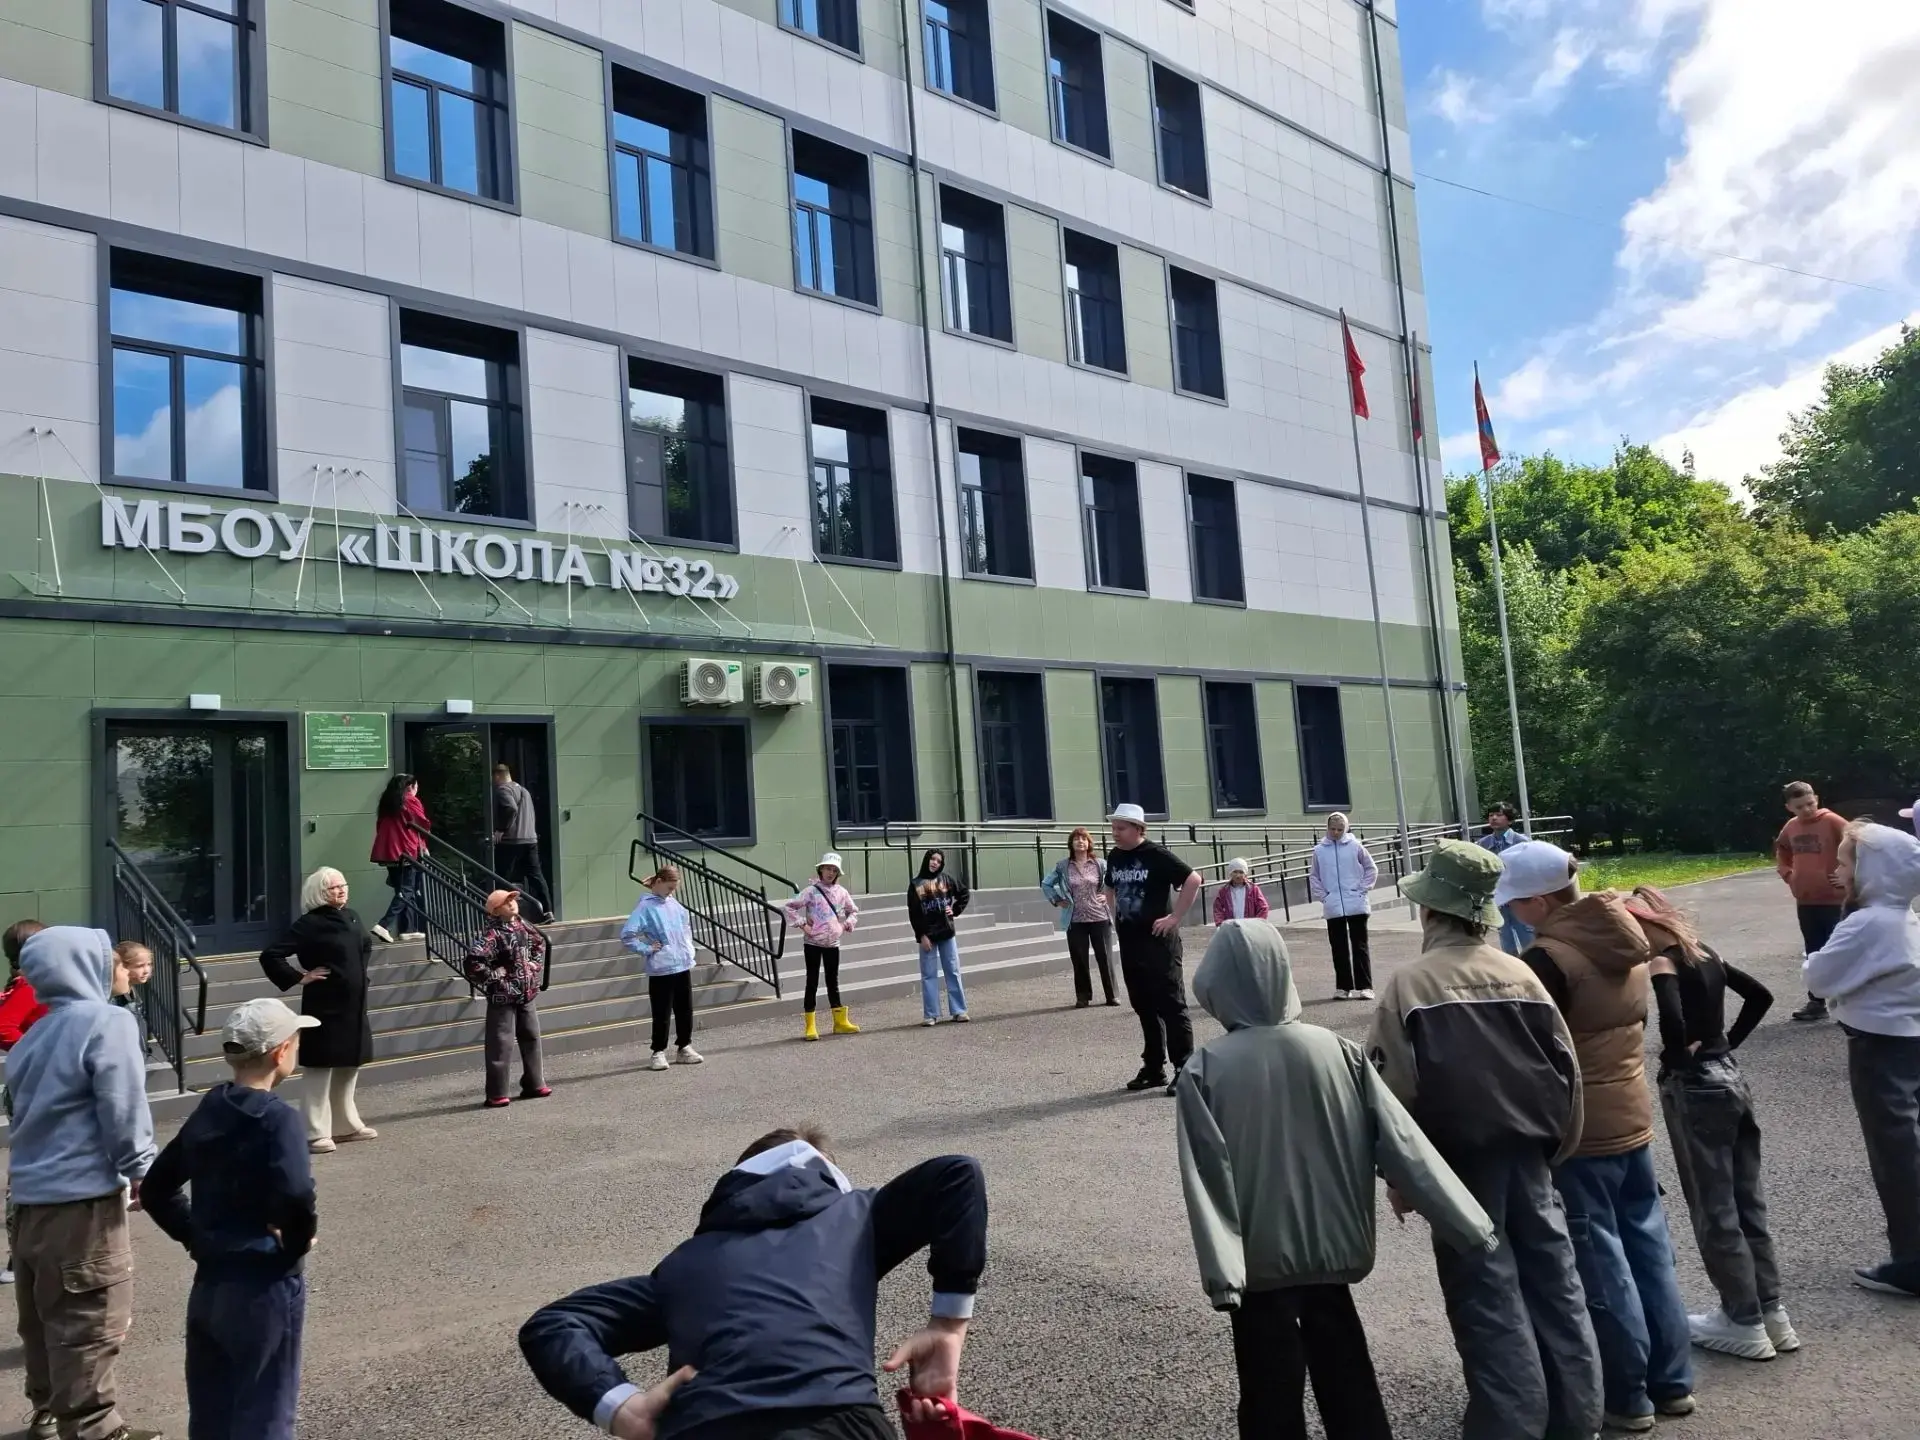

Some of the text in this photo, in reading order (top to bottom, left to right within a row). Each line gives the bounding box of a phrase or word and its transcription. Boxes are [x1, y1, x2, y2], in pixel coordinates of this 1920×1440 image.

[101, 495, 739, 600] МБОУ «ШКОЛА №32»
